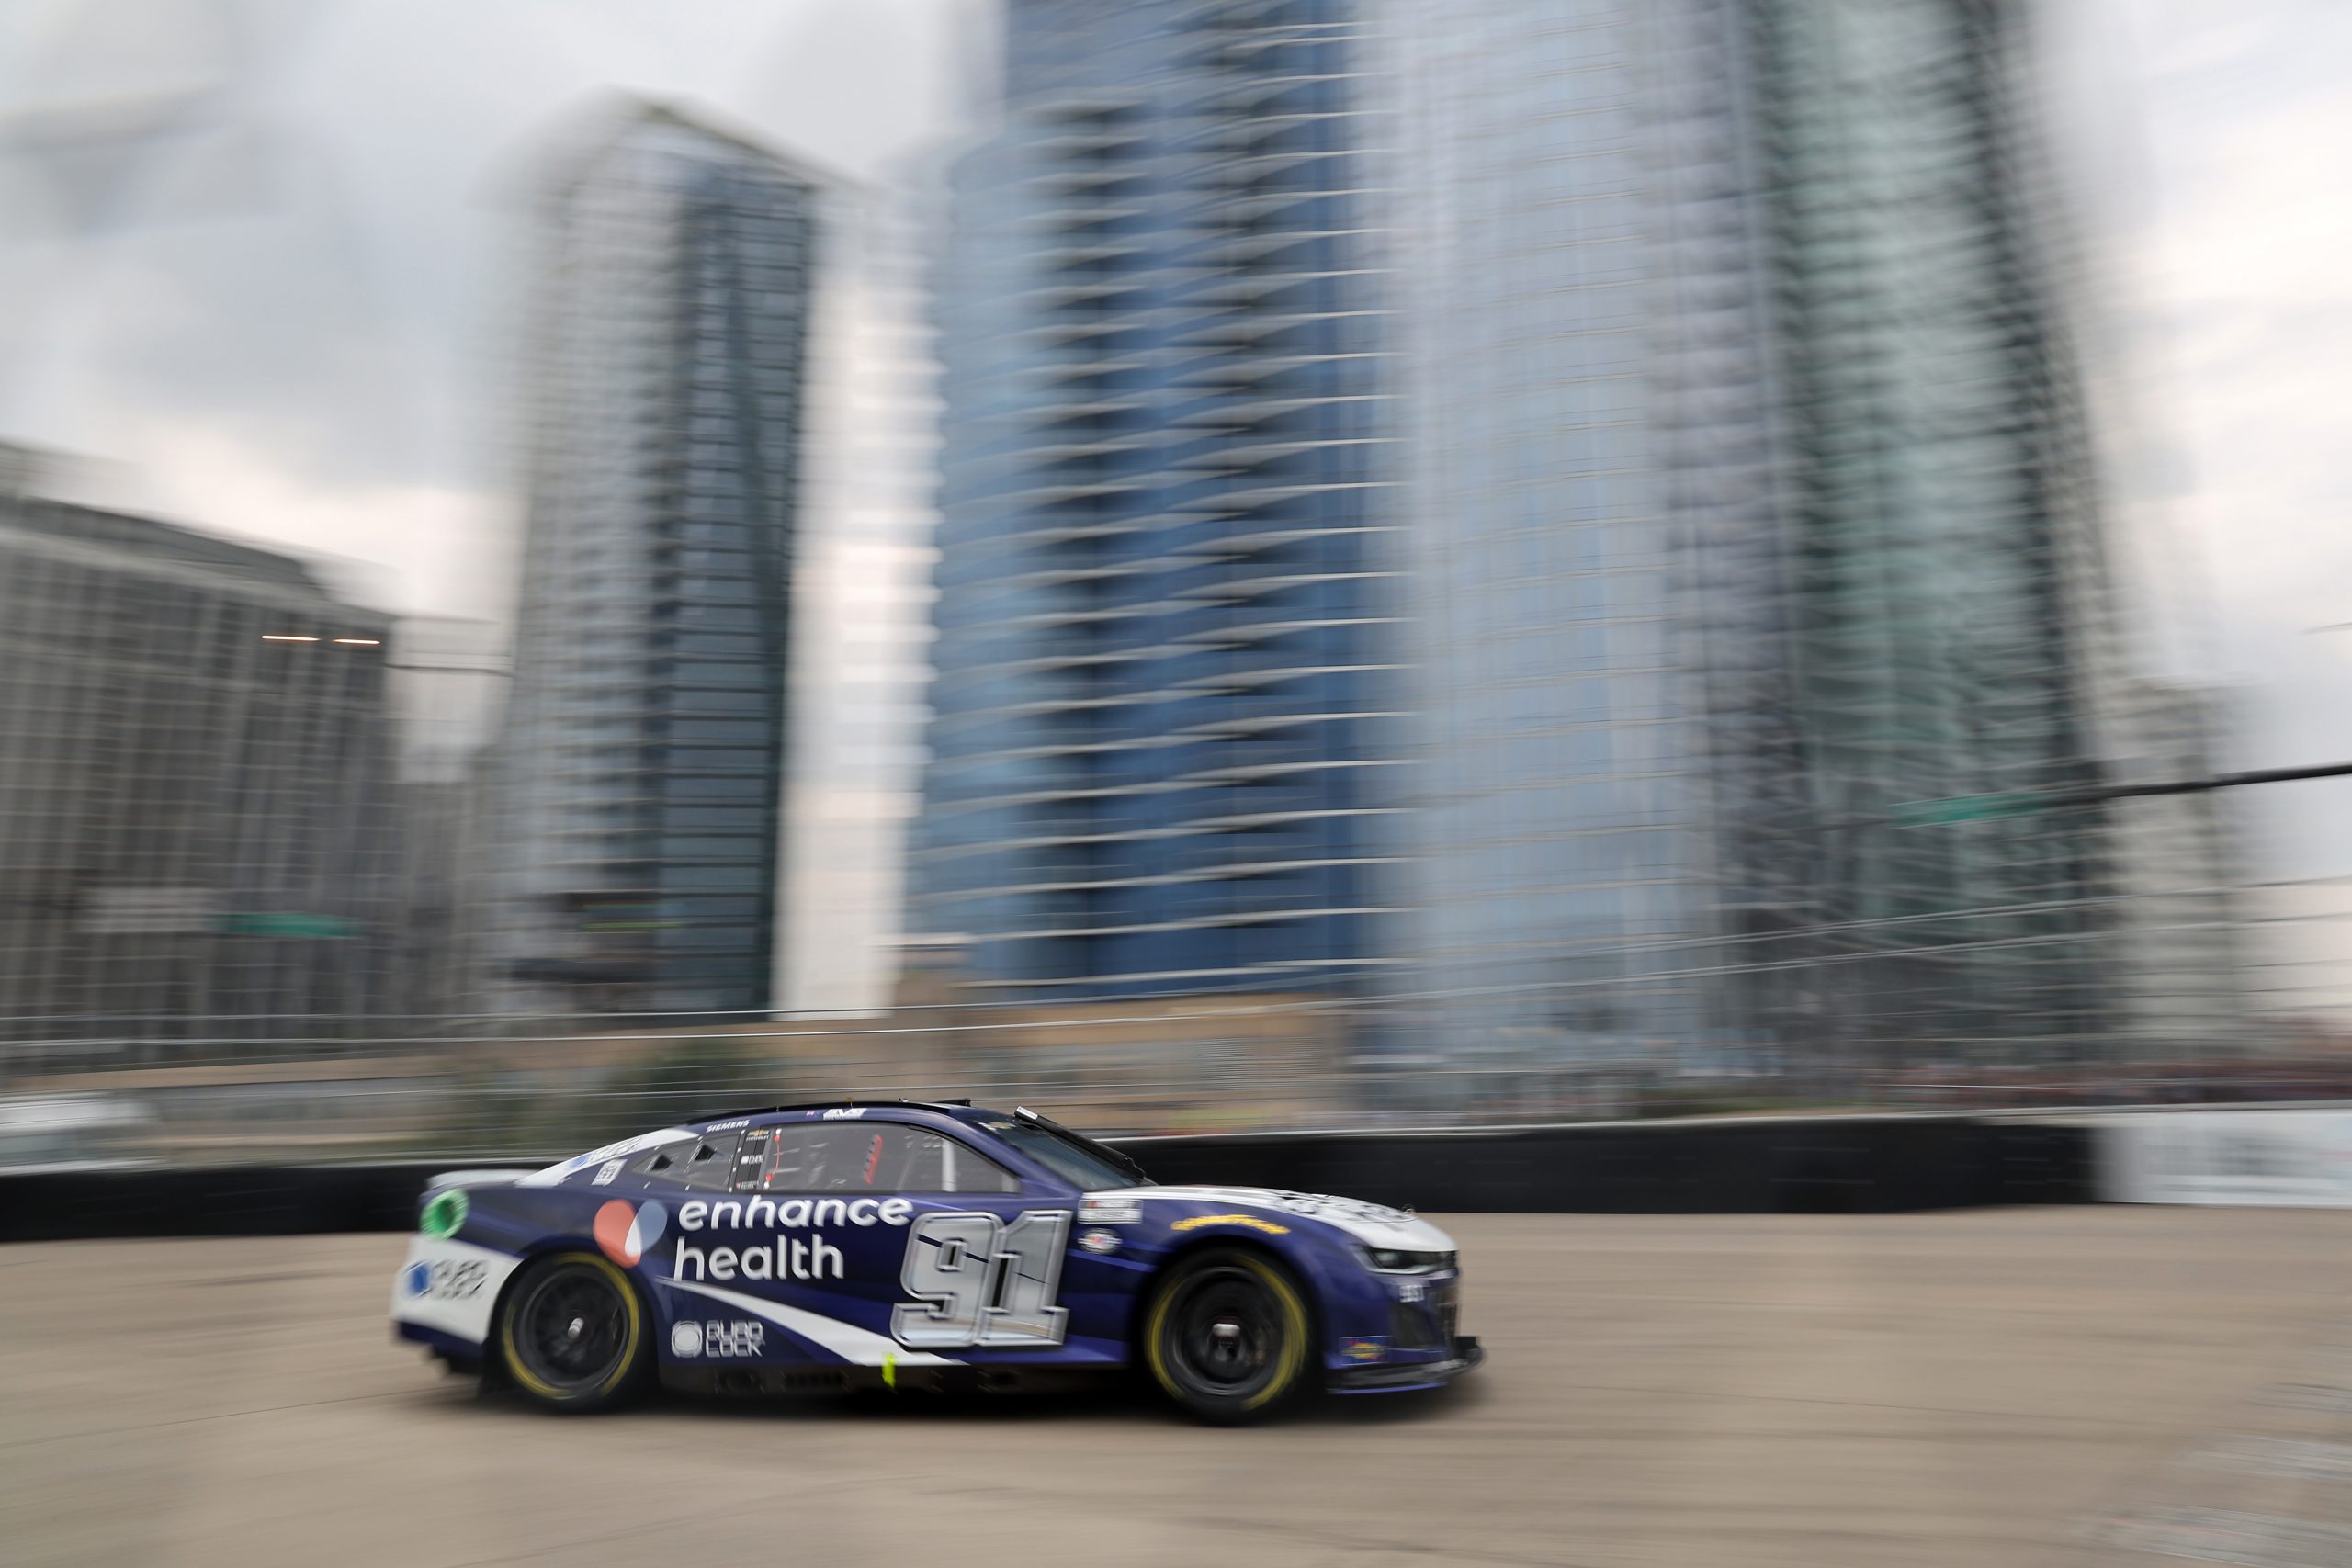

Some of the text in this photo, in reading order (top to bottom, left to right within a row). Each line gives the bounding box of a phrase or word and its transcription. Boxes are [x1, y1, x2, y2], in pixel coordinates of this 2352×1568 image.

[706, 1119, 750, 1133] SIEMENS
[678, 1195, 913, 1230] enhance
[673, 1234, 844, 1282] health
[889, 1210, 1073, 1348] 91
